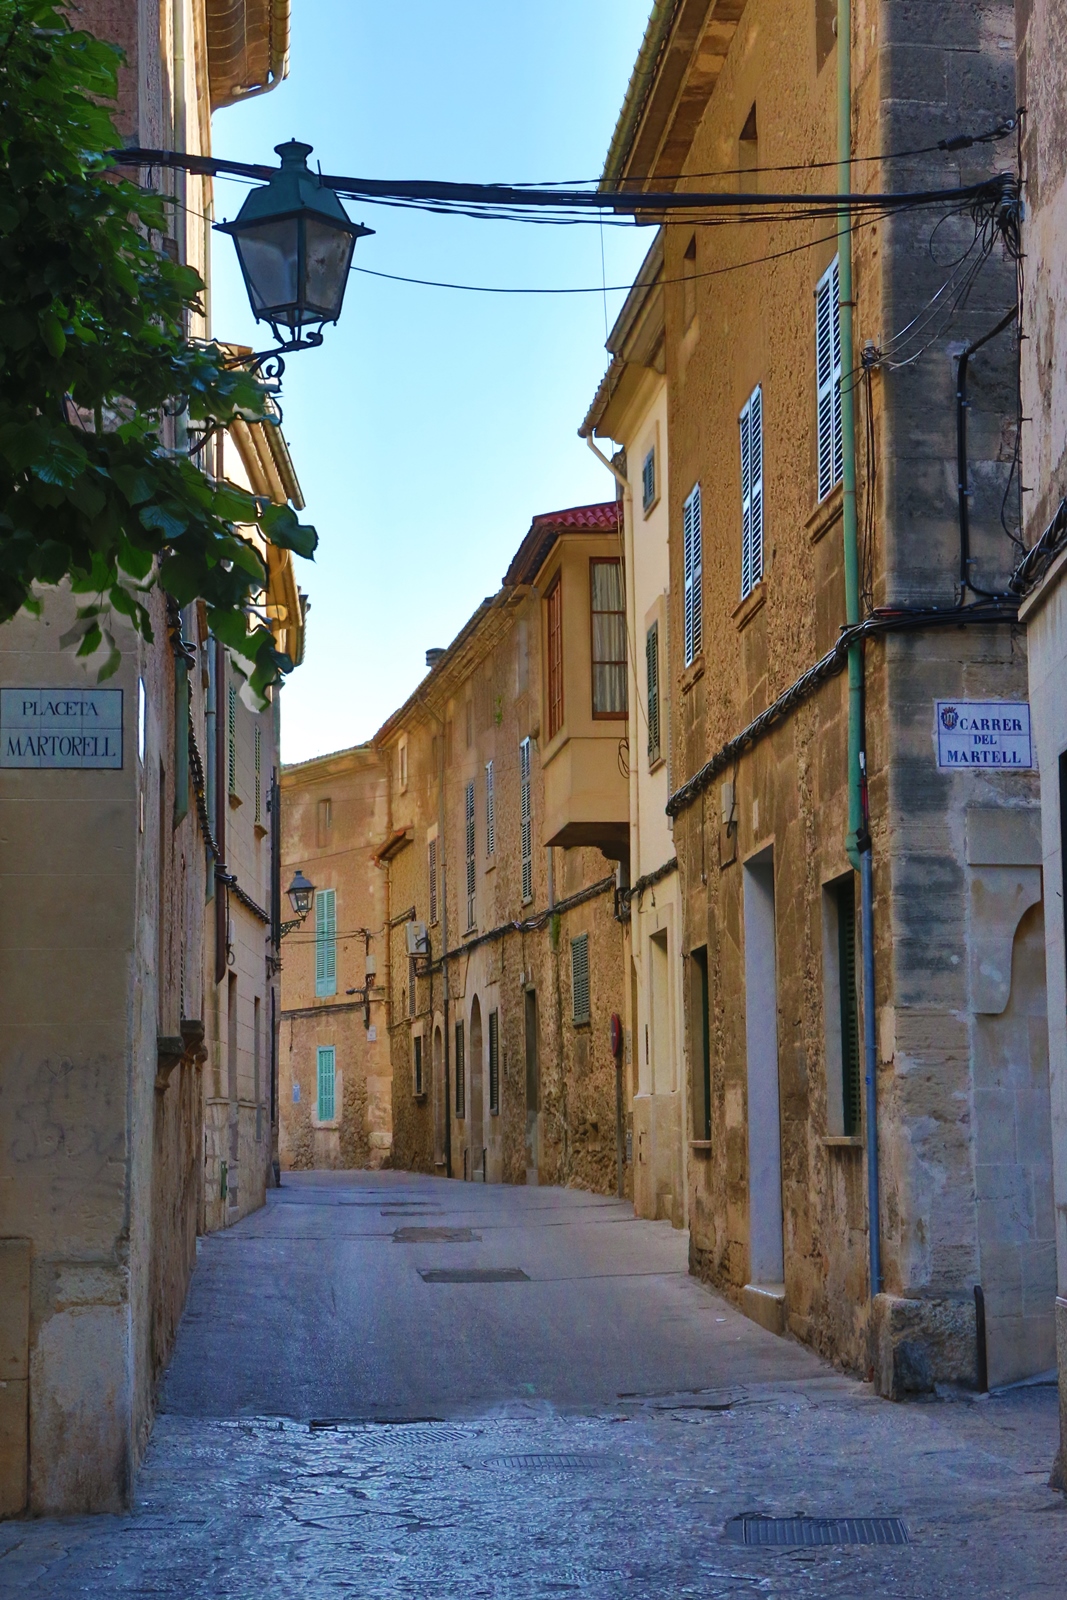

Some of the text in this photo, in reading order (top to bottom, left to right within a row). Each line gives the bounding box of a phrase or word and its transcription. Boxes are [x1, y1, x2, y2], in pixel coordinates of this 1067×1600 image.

[22, 701, 98, 716] PLACETA
[959, 718, 1022, 731] CARRER
[7, 736, 116, 757] MARTORELL
[973, 735, 997, 745] DEL
[947, 750, 1021, 763] MARTELL
